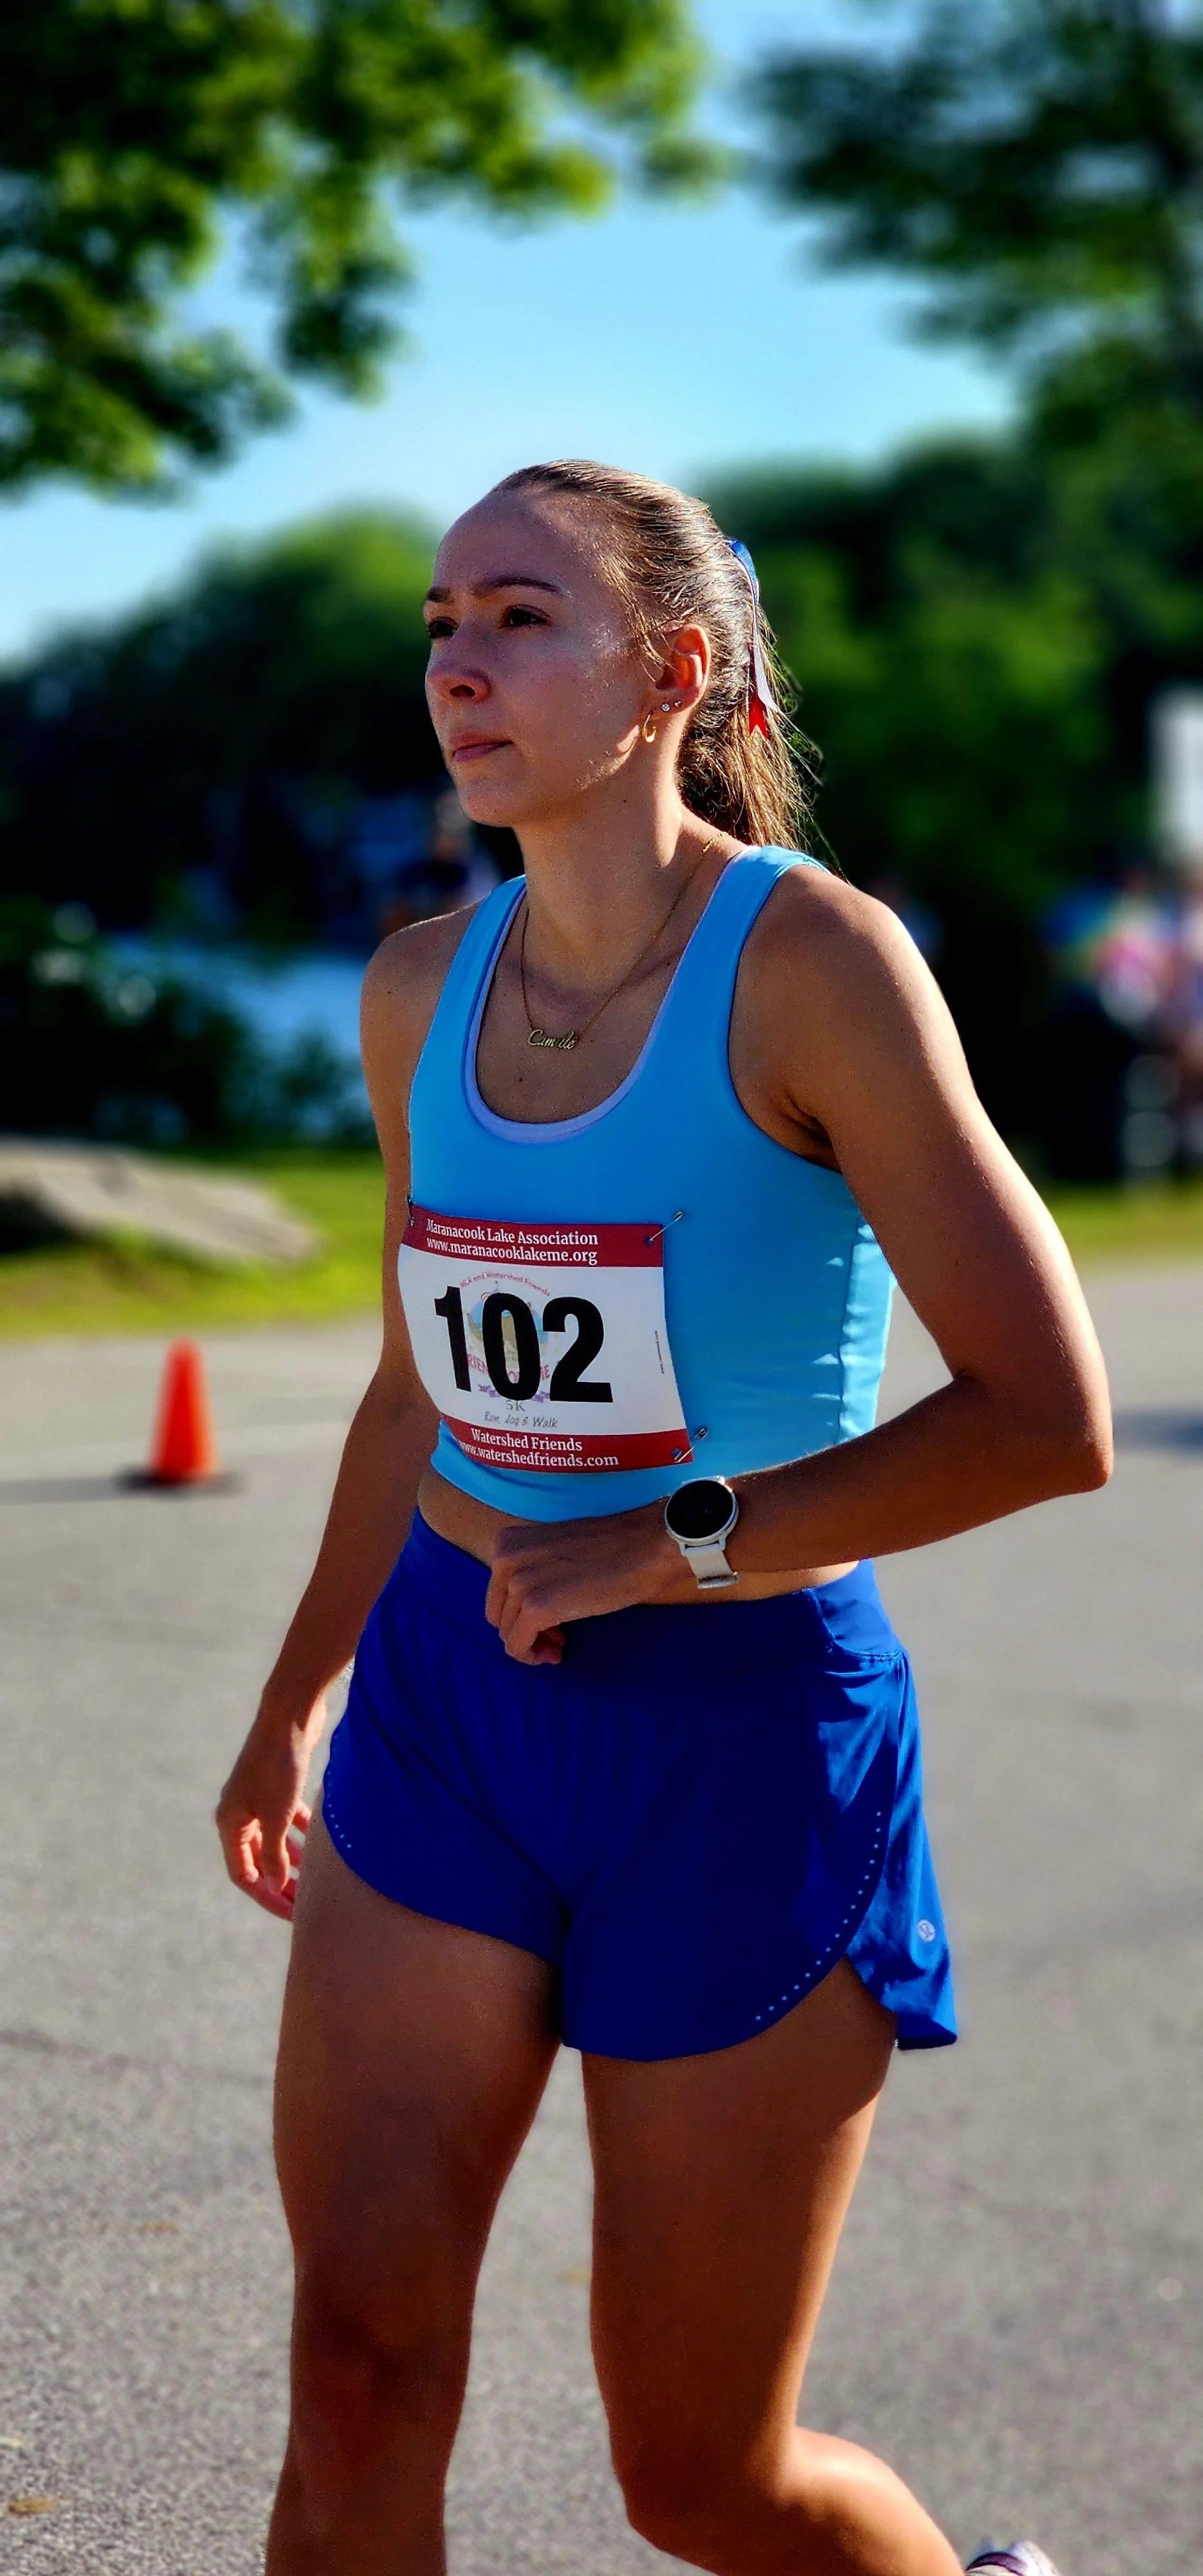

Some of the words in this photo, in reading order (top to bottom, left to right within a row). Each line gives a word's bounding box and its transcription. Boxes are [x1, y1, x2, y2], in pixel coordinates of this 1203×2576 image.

[426, 1219, 486, 1240] Maranacook
[488, 1228, 515, 1243] Lake
[518, 1231, 598, 1245] Association
[427, 1238, 598, 1265] www.maranacooklakeme.org
[434, 1286, 613, 1403] 102
[506, 1400, 526, 1412] 5K
[533, 1417, 558, 1428] Walk
[471, 1428, 529, 1448] Watershed
[531, 1437, 583, 1451] Friends
